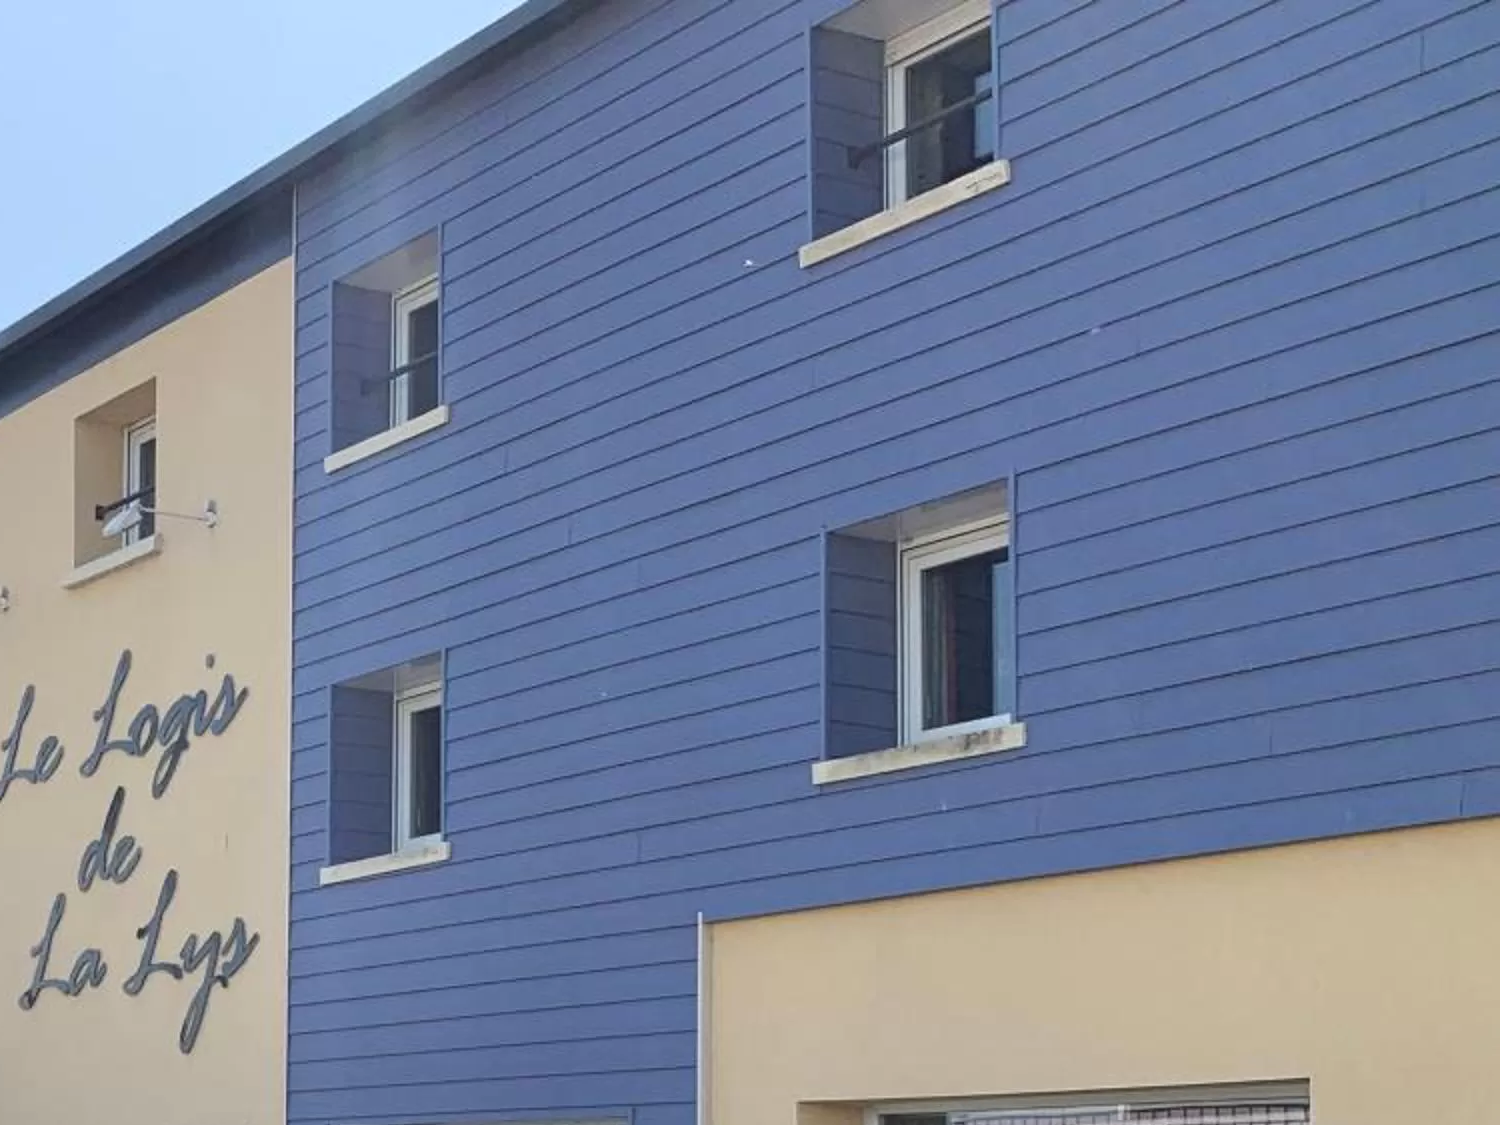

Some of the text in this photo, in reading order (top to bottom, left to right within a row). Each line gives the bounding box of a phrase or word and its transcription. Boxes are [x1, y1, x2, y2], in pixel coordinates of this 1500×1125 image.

[79, 649, 249, 799] Logis
[78, 785, 143, 892] de
[18, 868, 261, 1055] La Lys
